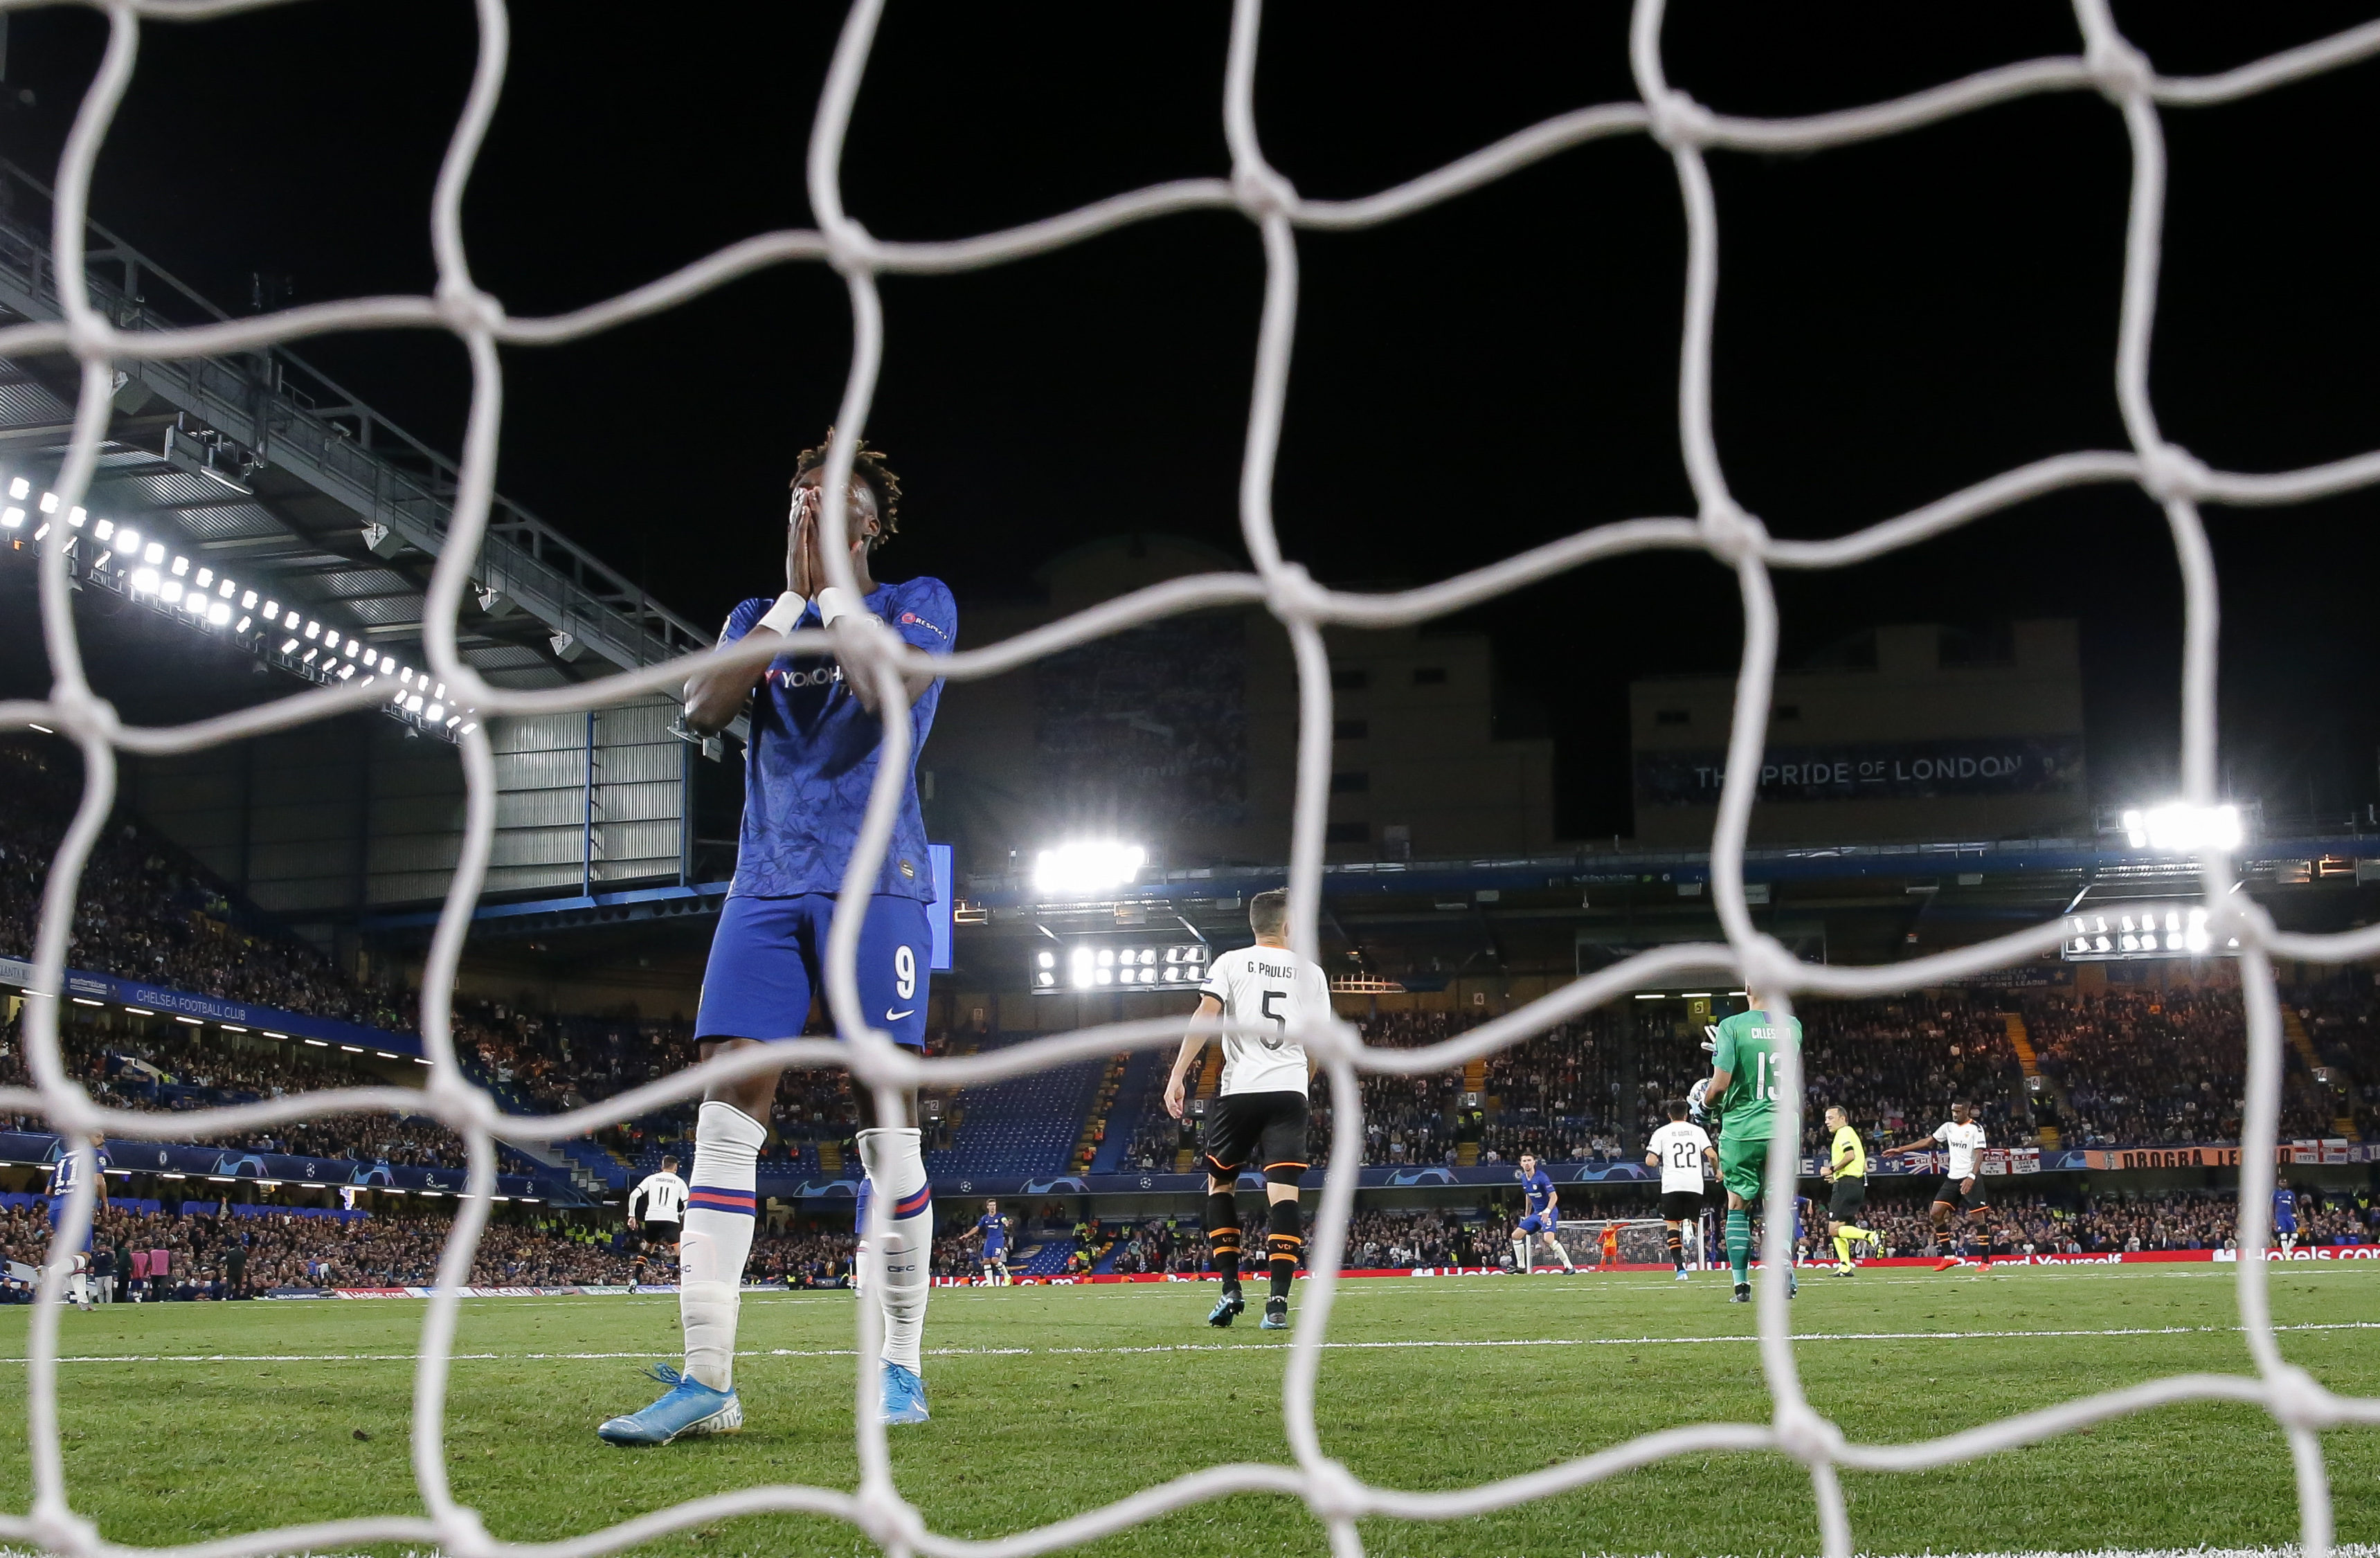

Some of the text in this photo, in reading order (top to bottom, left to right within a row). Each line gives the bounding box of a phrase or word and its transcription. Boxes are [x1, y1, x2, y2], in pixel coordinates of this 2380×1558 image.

[915, 617, 947, 640] RESPECT
[782, 665, 844, 688] YOKOH
[1695, 756, 2022, 788] TH PRIDE OF LONDON
[894, 945, 916, 1000] 9
[1247, 961, 1299, 980] G. PAULIST
[136, 990, 246, 1020] CHELSEA FOOTBALL CLUB
[1260, 990, 1287, 1050] 5
[1756, 1052, 1784, 1100] 13
[1673, 1142, 1697, 1168] 22
[2123, 1149, 2203, 1168] DROGBA
[55, 1155, 80, 1188] 11
[659, 1186, 669, 1206] 11
[1956, 1253, 2122, 1267] Reard Yourself
